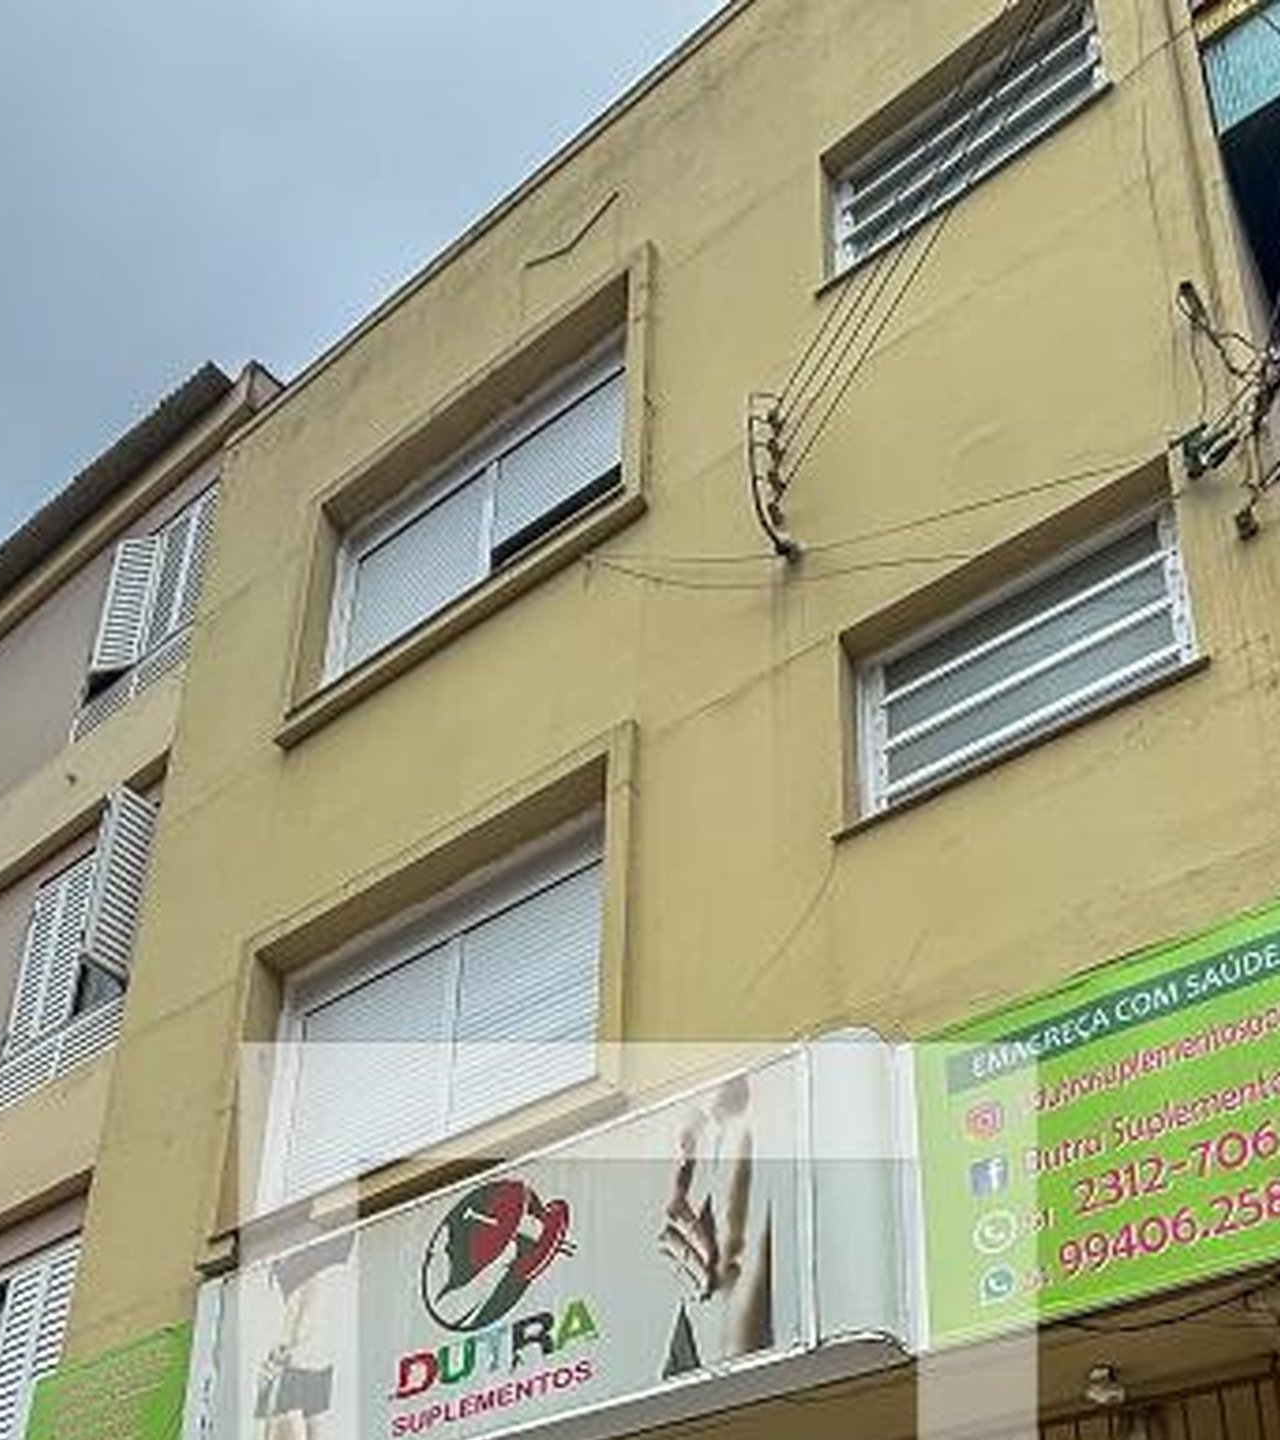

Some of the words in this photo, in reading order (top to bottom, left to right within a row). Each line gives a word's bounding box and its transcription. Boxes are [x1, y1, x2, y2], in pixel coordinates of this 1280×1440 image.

[971, 1007, 1111, 1078] EMAGREÇA
[1115, 982, 1179, 1023] COM
[390, 1299, 601, 1400] DUTRA
[391, 1360, 594, 1439] SUPLEMENTOS
